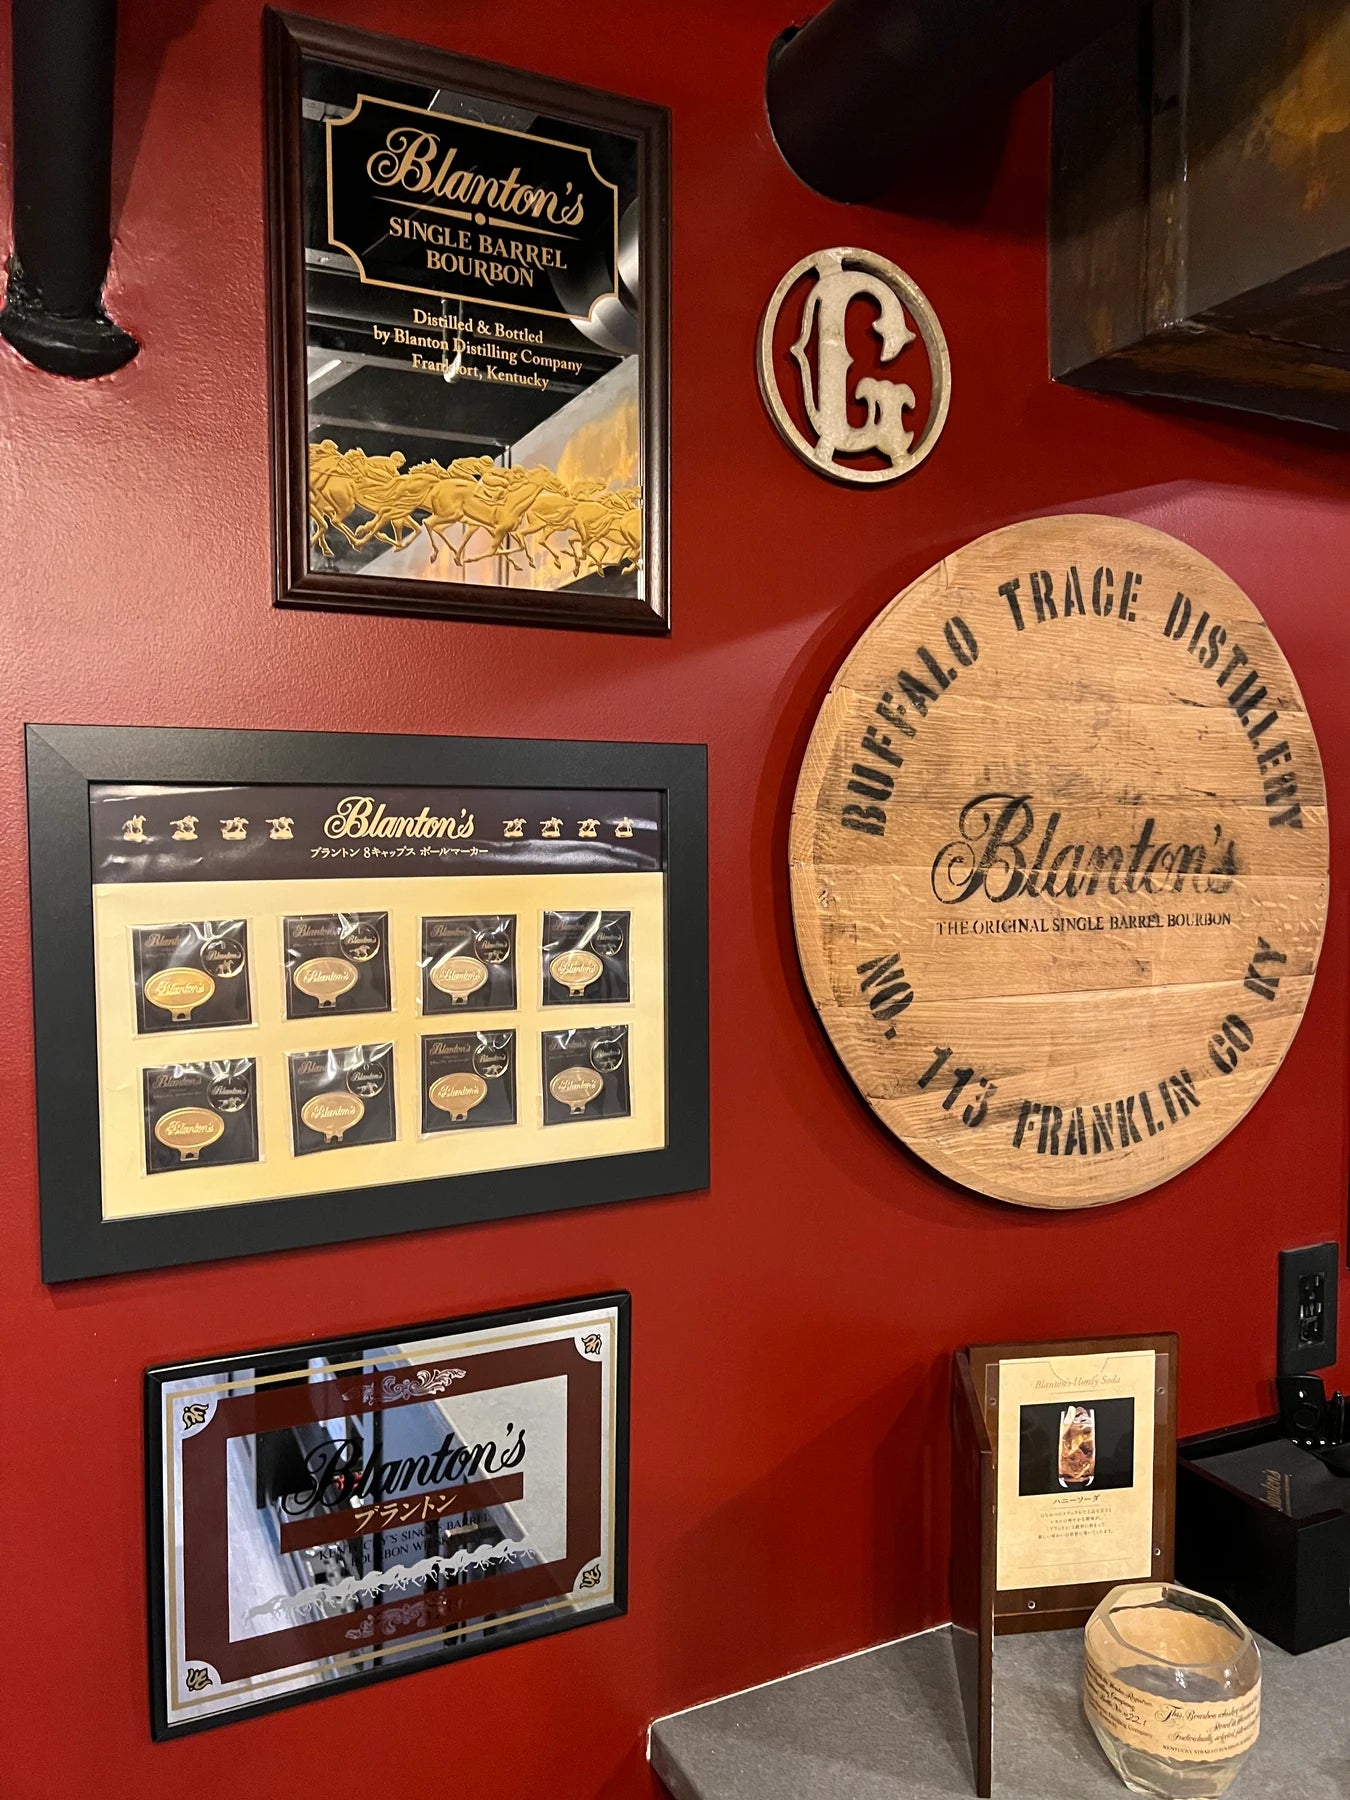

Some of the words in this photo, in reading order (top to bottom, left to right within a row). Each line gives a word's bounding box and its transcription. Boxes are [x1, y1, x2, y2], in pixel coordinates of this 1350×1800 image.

[366, 127, 584, 226] Blanton's
[389, 217, 471, 250] SINGLE
[479, 234, 567, 270] BARREL
[426, 249, 534, 287] BOURBON
[413, 308, 473, 332] Distilled
[477, 321, 491, 335] &
[495, 322, 543, 344] Bottled
[373, 325, 390, 345] by
[394, 327, 449, 350] Blanton
[453, 338, 517, 365] Distilling
[521, 349, 583, 375] Company
[411, 353, 483, 380] Frankort,
[487, 364, 549, 391] Kentucky
[841, 616, 980, 837] BUFFALO
[998, 565, 1143, 631] TRACE
[1163, 591, 1304, 830] DISTILLERY
[323, 796, 475, 839] Blanton's
[310, 847, 361, 860] ブラントン
[363, 845, 416, 859] 8キャップス
[420, 846, 489, 857] ボールマーカー
[931, 792, 1238, 905] Blanton's
[937, 919, 968, 936] THE
[973, 917, 1049, 935] ORIGINAL
[1053, 915, 1104, 932] SINGLE
[1110, 913, 1164, 930] BARREL
[1167, 911, 1231, 927] BOURBON
[856, 952, 914, 1041] NO.
[917, 1046, 998, 1127] 113
[1012, 1068, 1201, 1156] FRANKLIN
[1208, 1013, 1254, 1075] CO
[1243, 935, 1287, 1002] KY
[281, 1422, 526, 1516] Blanton's
[354, 1495, 457, 1533] ブラントン
[1053, 1494, 1100, 1504] ハニーソーダ
